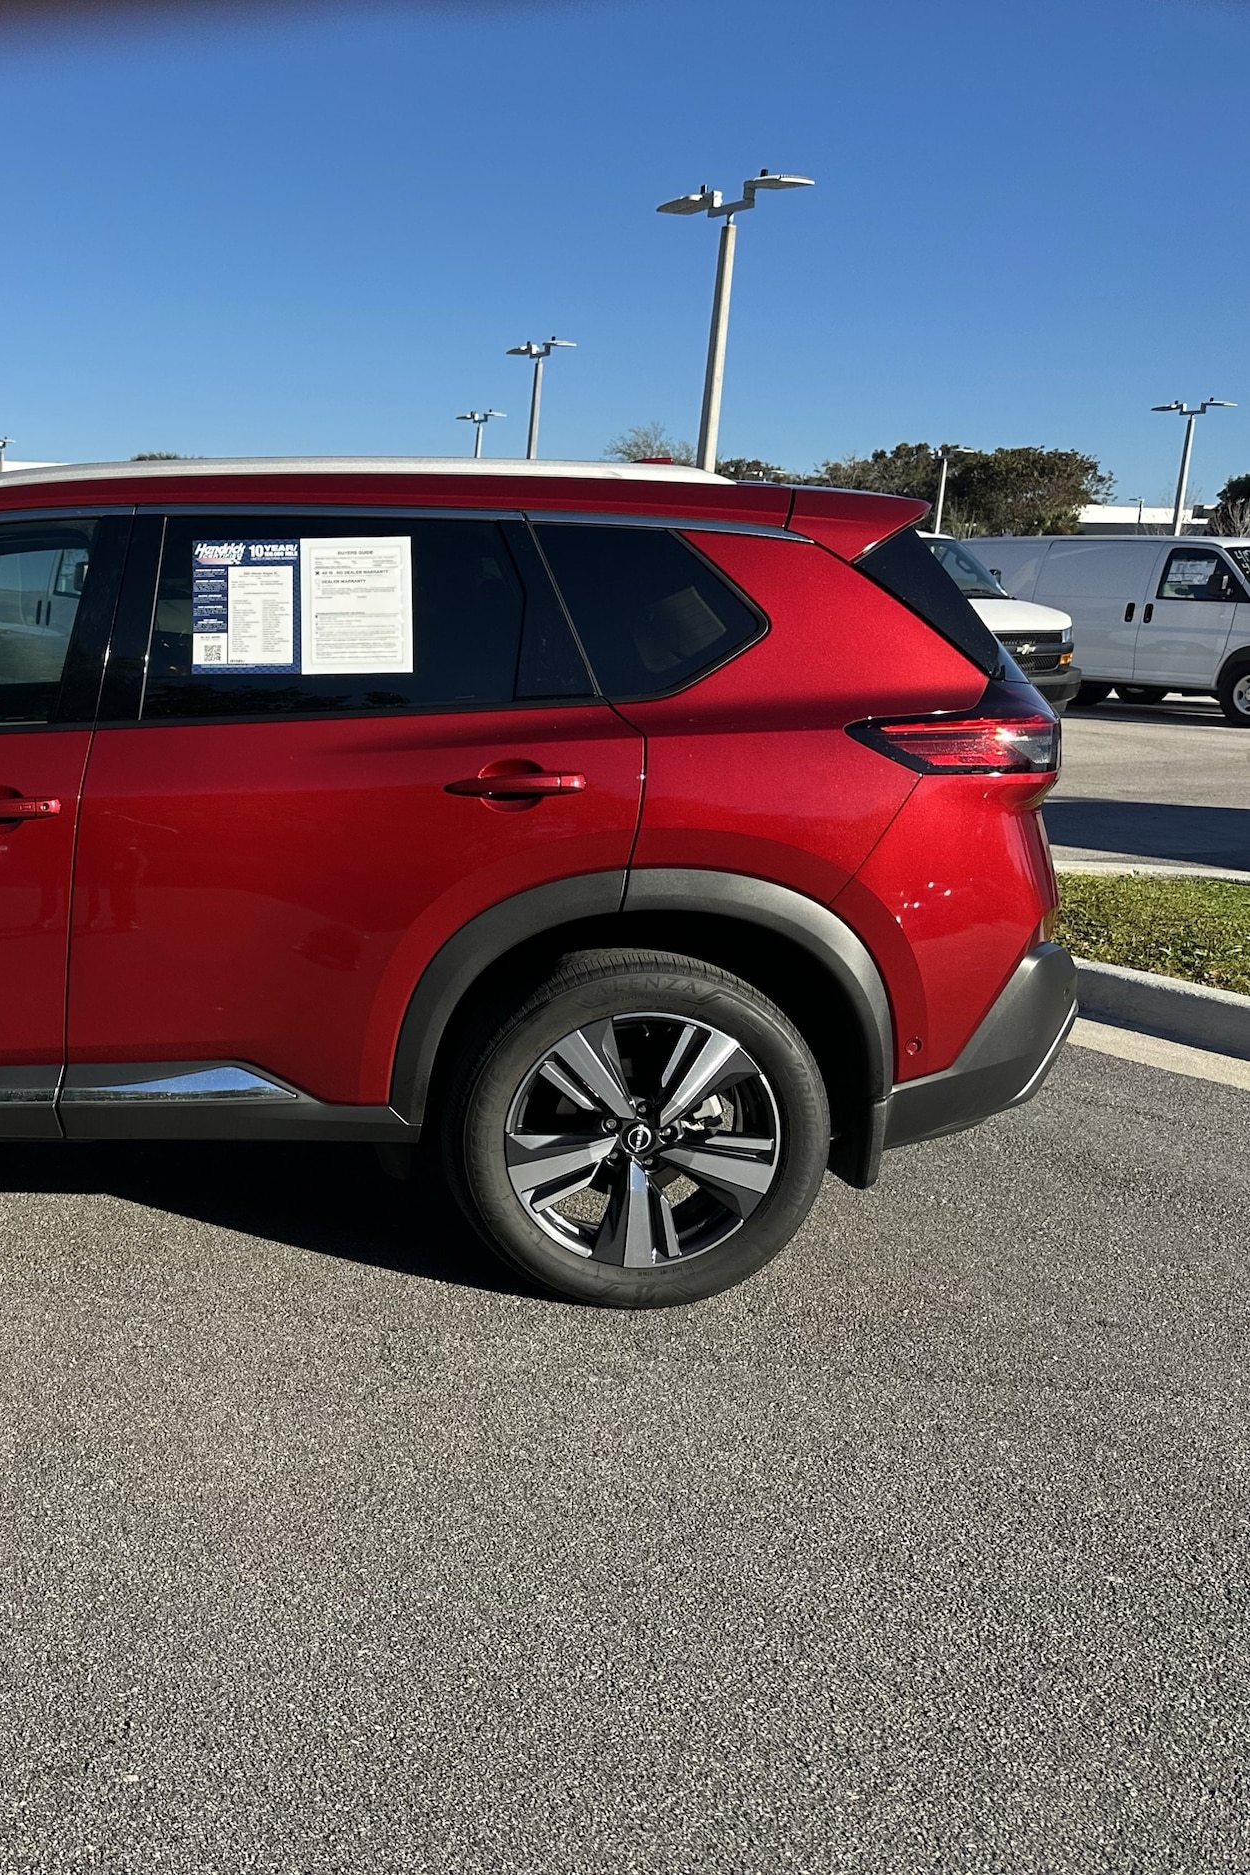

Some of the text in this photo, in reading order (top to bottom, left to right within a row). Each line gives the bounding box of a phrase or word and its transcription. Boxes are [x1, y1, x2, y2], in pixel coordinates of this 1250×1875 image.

[195, 543, 246, 558] Hendrick
[249, 544, 264, 557] 10
[596, 976, 697, 997] ALENZA
